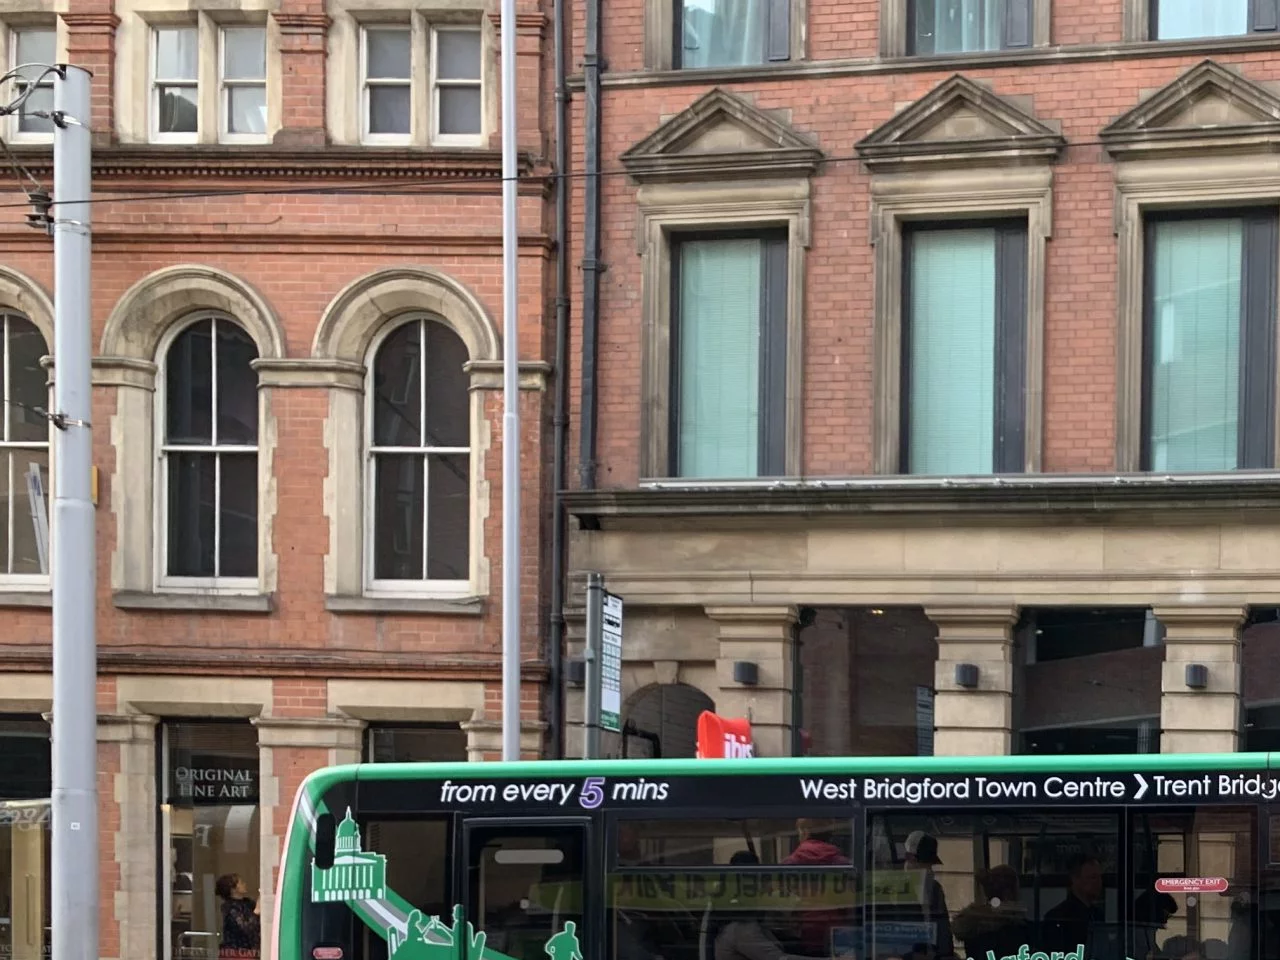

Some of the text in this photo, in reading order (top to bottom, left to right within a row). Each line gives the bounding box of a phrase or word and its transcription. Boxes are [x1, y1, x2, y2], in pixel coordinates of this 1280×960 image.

[175, 766, 254, 782] ORIGINAL
[219, 784, 250, 798] ART
[440, 777, 670, 809] from every 5 mins
[799, 777, 857, 800] West
[863, 777, 970, 804] Bridgford
[975, 776, 1037, 798] Town
[1043, 775, 1126, 798] Centre
[1153, 774, 1211, 796] Trent
[1161, 878, 1204, 886] EMERGENCY
